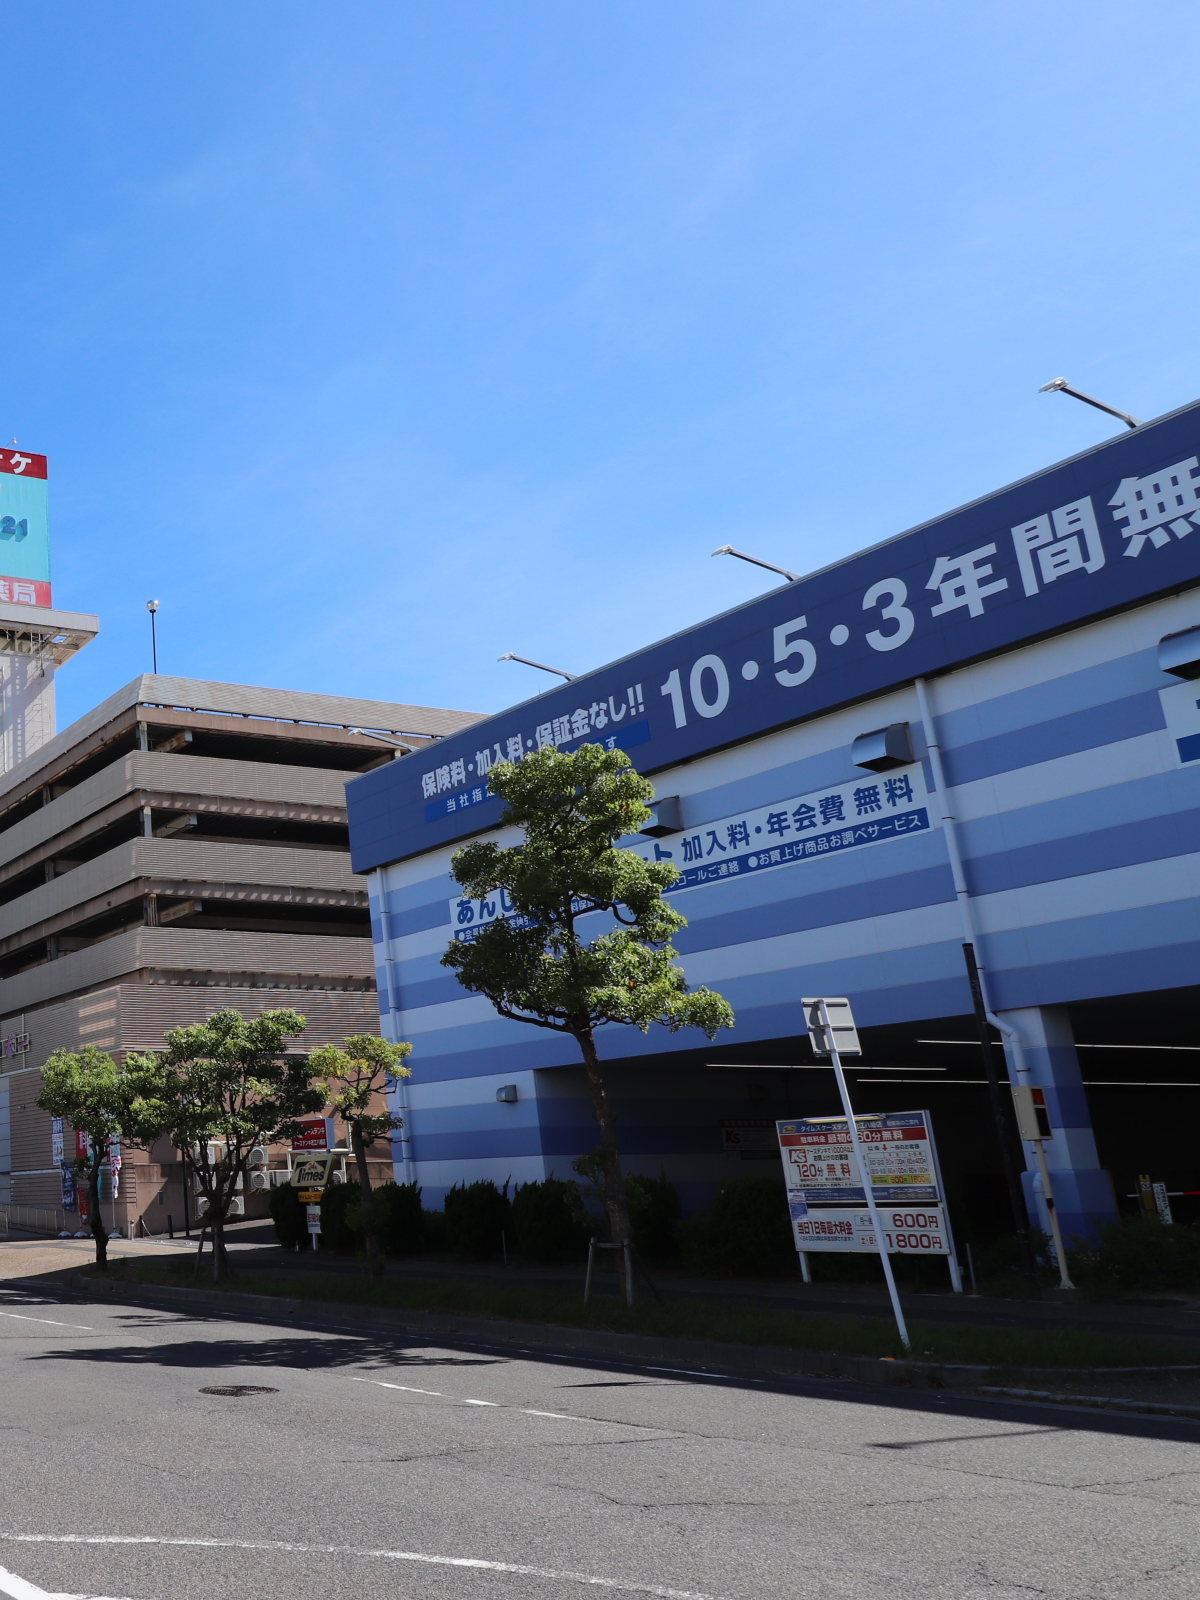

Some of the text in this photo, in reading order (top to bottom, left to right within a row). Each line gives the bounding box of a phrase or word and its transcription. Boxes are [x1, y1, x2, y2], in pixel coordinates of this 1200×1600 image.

[681, 795, 846, 863] 加入料・年会費
[853, 774, 914, 816] 無料
[759, 815, 921, 865] お買上げ商品お調べサービス
[893, 1213, 939, 1228] 600円
[886, 1233, 943, 1249] 1800円
